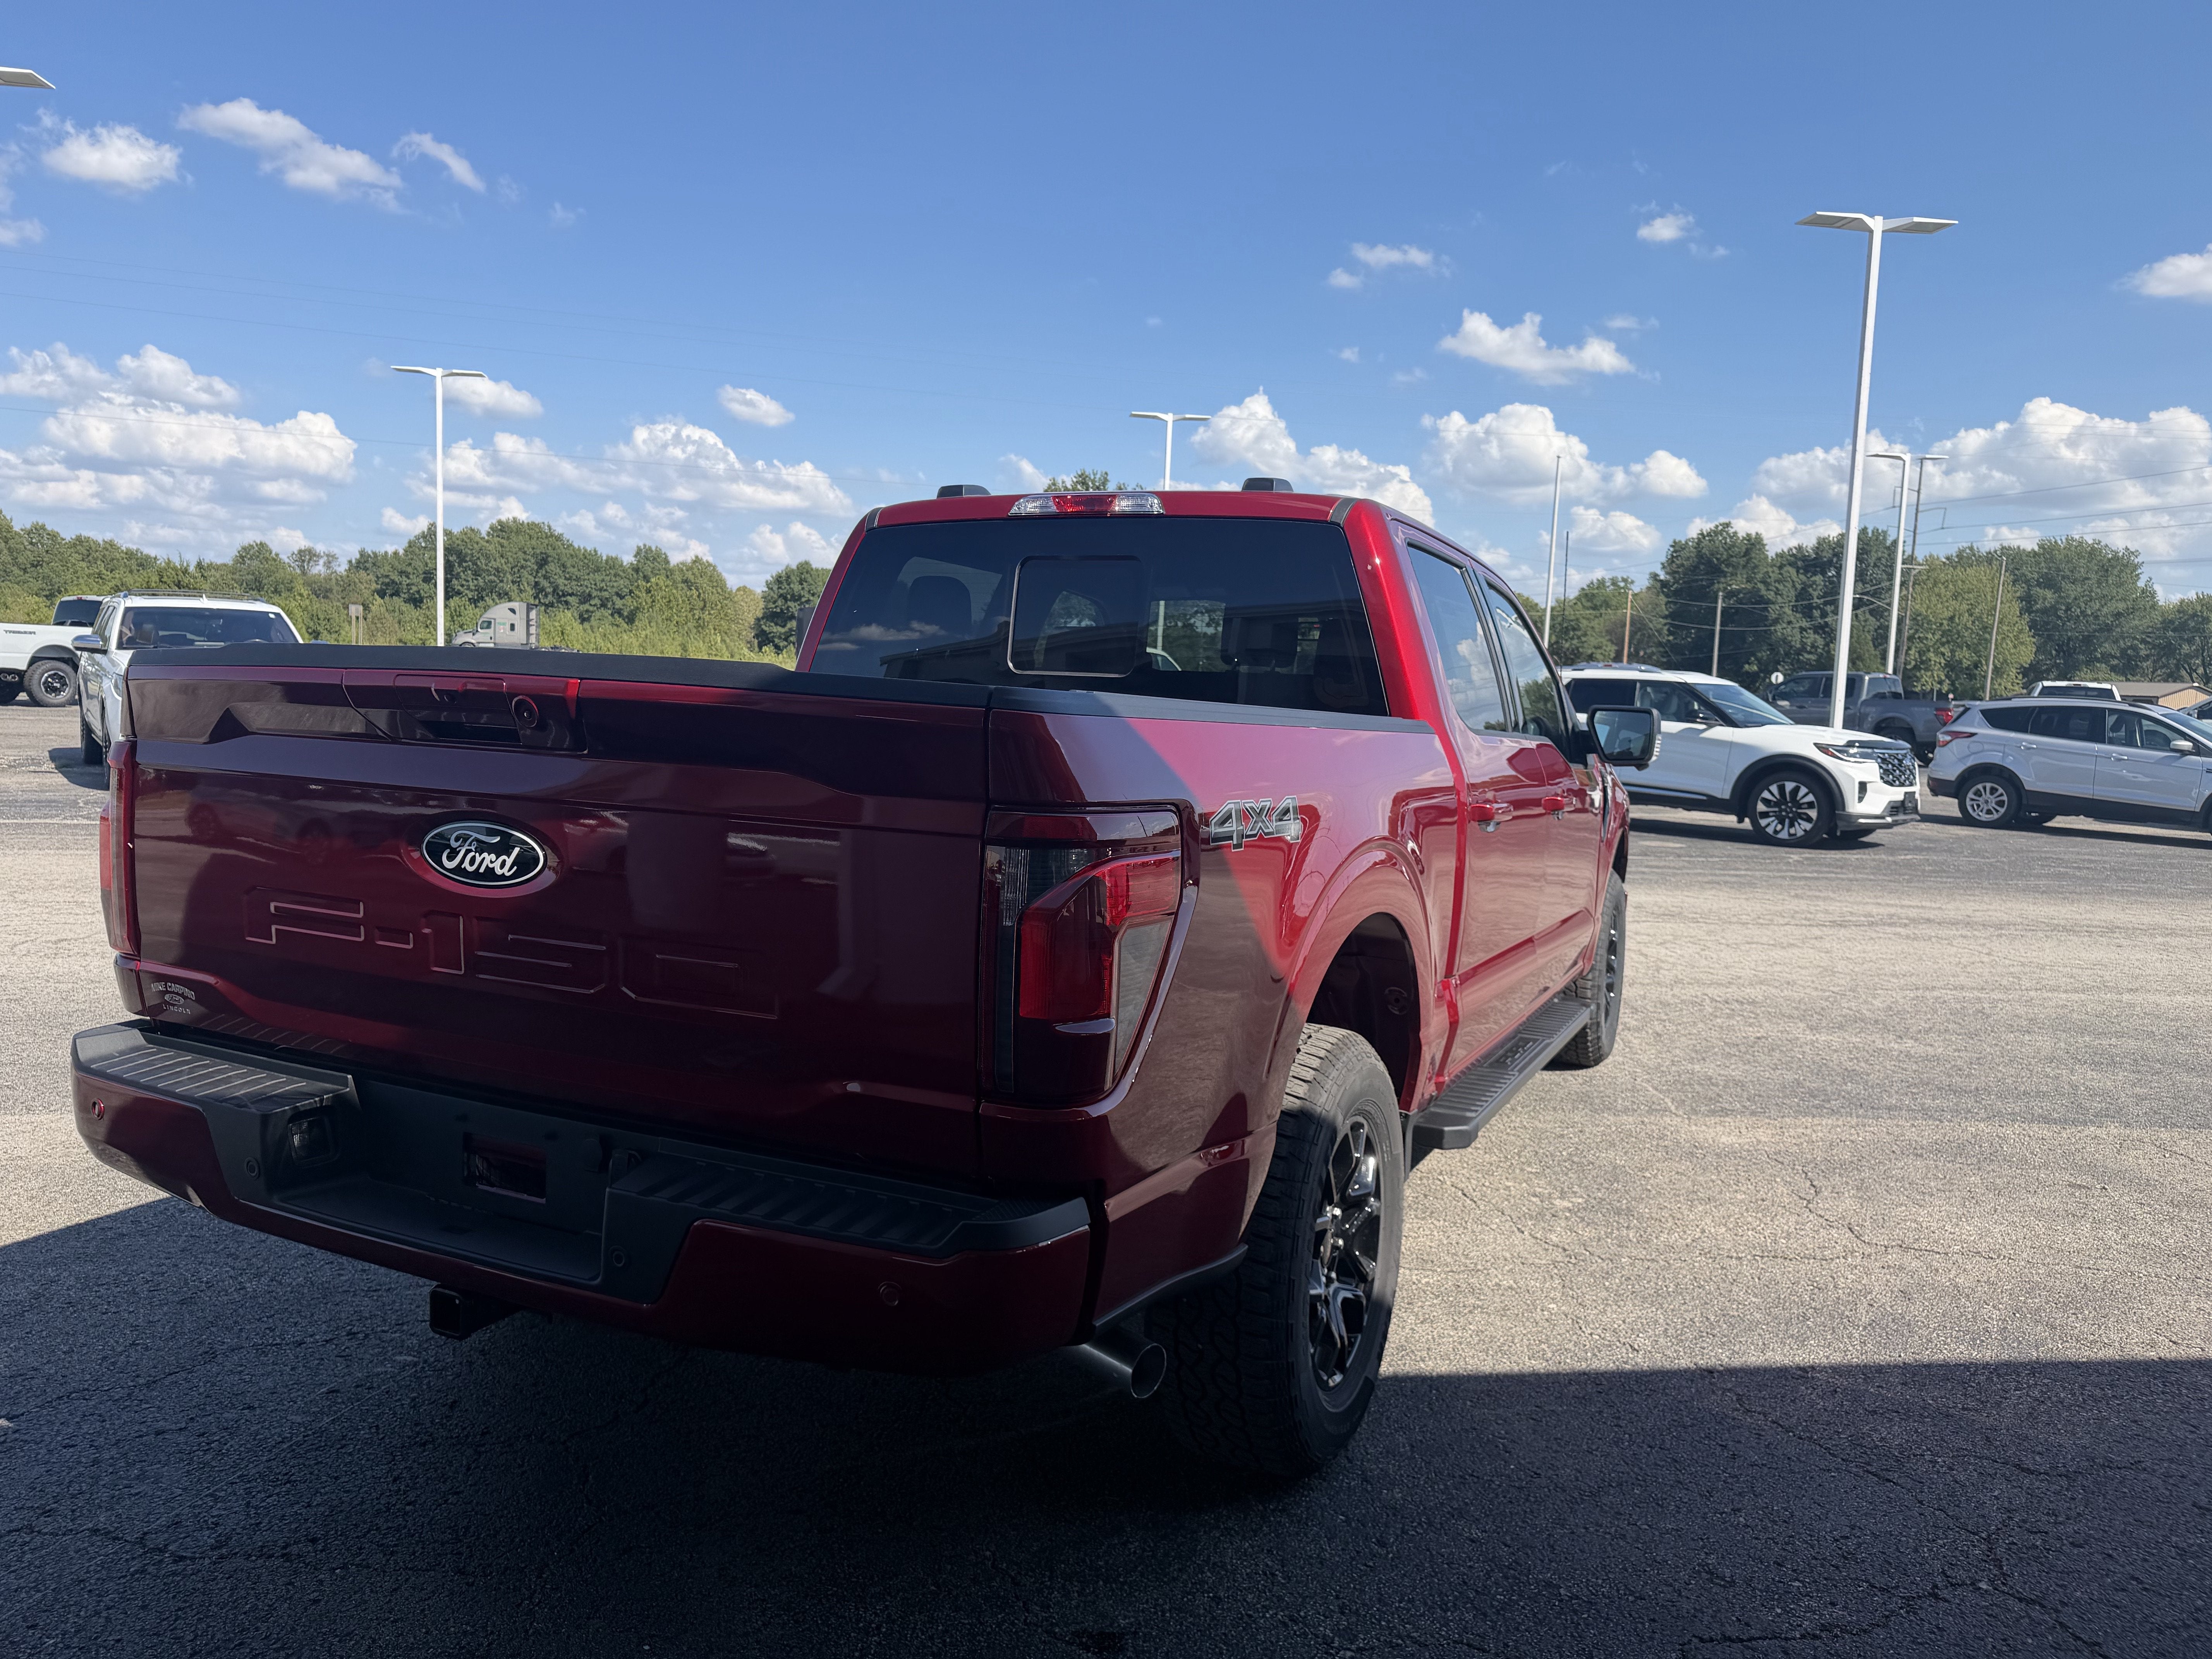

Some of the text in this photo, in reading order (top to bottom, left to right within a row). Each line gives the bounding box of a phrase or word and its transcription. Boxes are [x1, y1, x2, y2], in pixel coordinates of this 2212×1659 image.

[442, 830, 520, 876] Ford
[244, 887, 780, 1020] F-150
[151, 982, 166, 992] MIKE
[163, 1004, 191, 1014] LINCOLN
